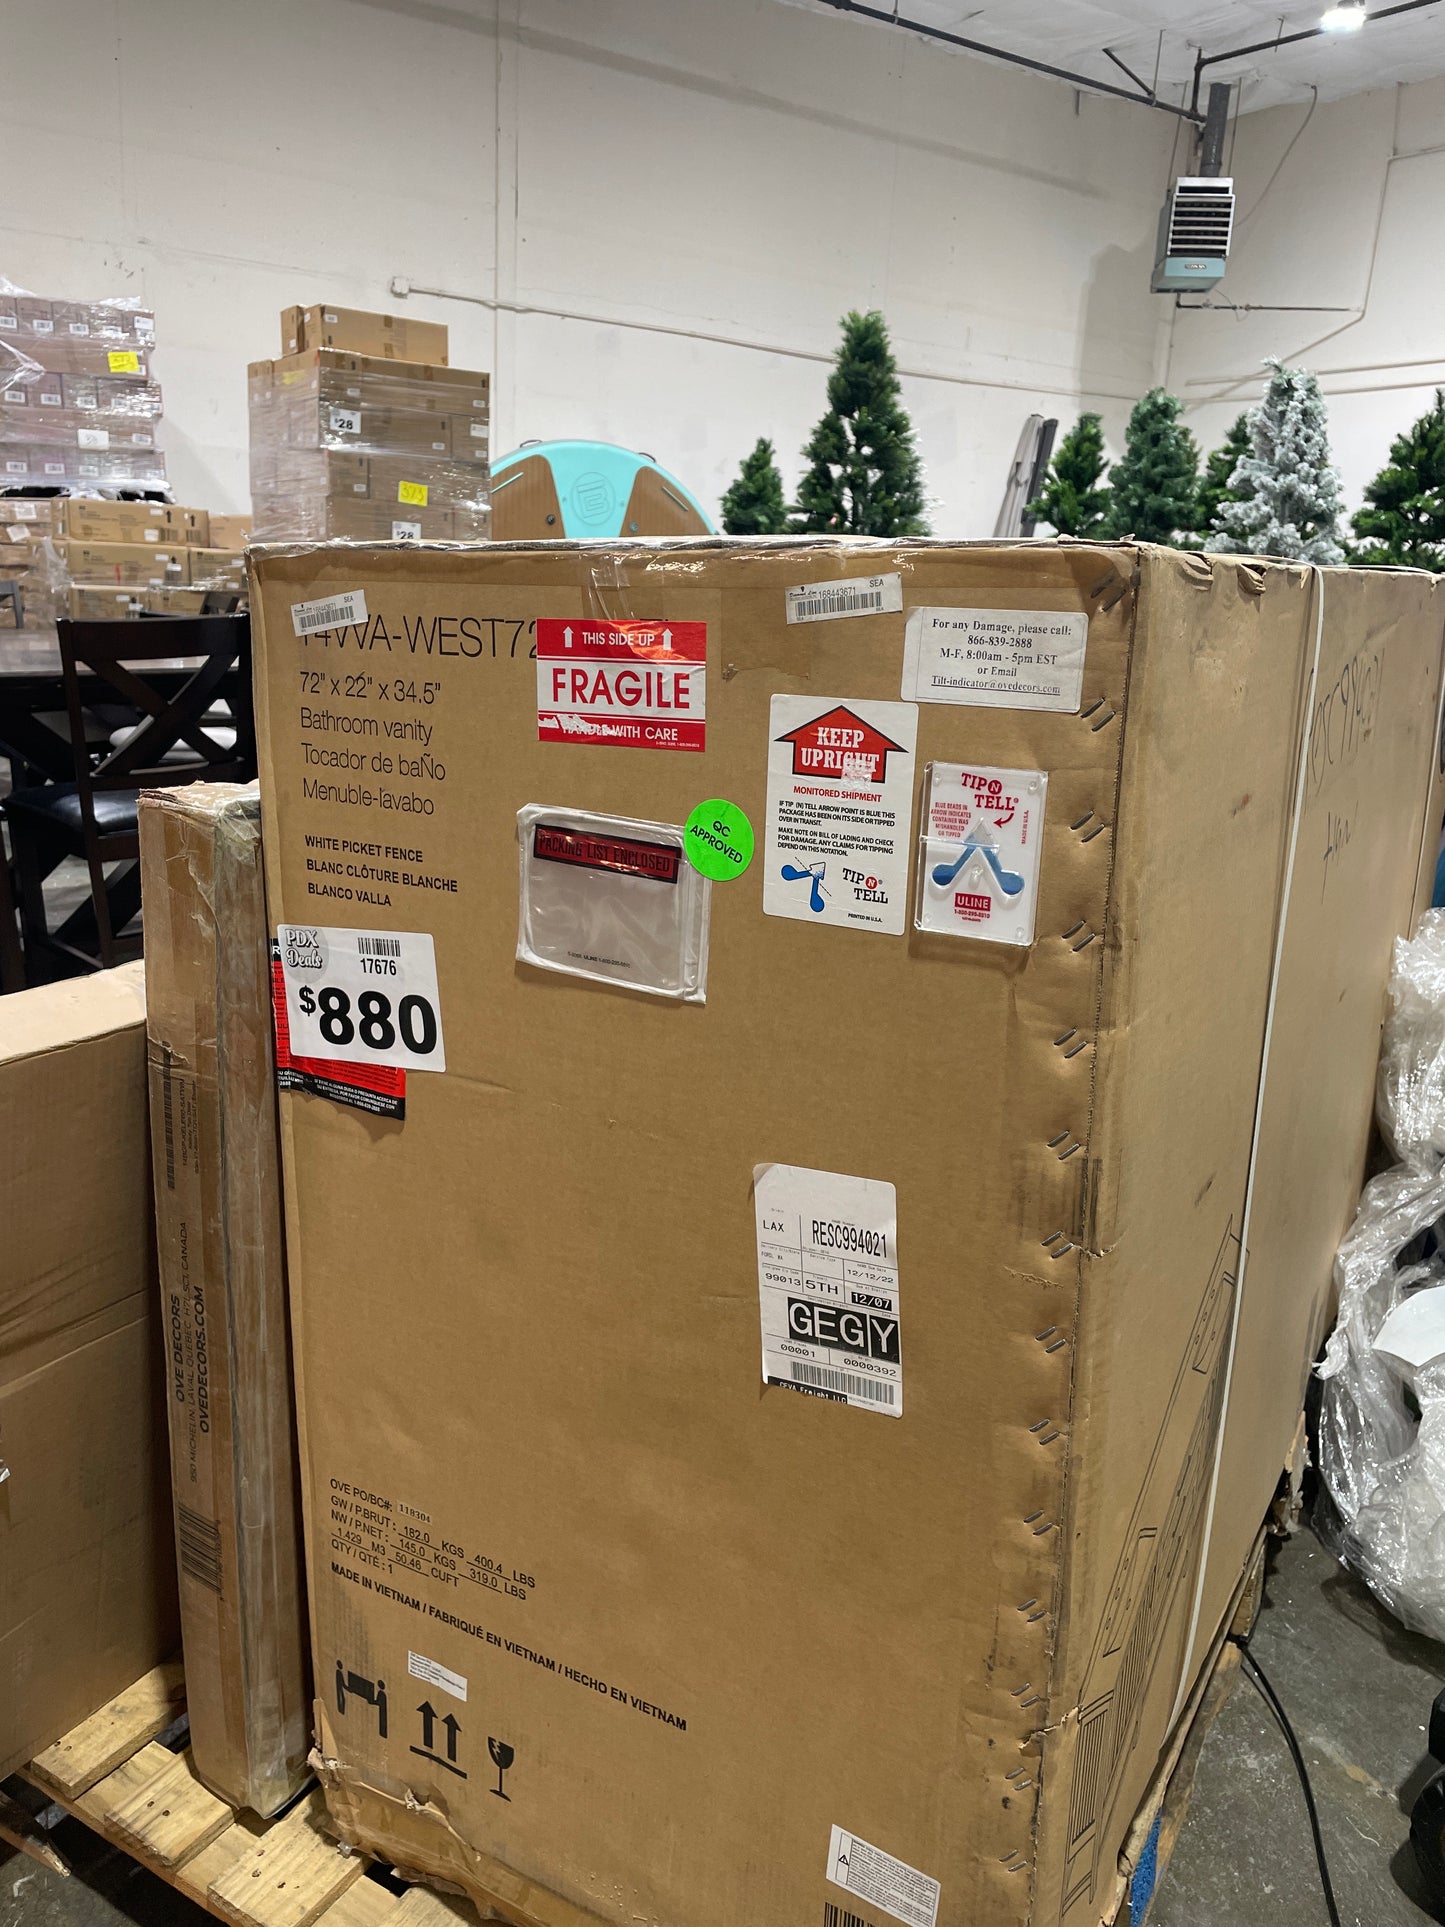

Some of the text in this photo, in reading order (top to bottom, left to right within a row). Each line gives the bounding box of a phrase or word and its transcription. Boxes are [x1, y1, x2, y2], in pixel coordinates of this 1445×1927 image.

[869, 578, 884, 588] SEA
[819, 587, 856, 600] 168443671
[932, 618, 1072, 635] For any Damage, please call:
[582, 632, 655, 646] THIS SIDE UP
[968, 635, 1032, 648] 866-839-2888
[940, 648, 1058, 664] M-F, 8:00am 5pm EST
[991, 666, 1017, 676] Email
[300, 671, 440, 704] 72" x 22" x 34.5"
[552, 668, 690, 708] FRAGILE
[301, 707, 432, 746] Bathroom vanity
[612, 725, 640, 738] WITH
[645, 727, 678, 740] CARE
[817, 727, 864, 748] KEEP
[301, 742, 446, 780] Tocador de baÑo
[801, 748, 880, 772] UPRIGHT
[961, 773, 987, 790] TIP
[303, 778, 434, 815] Menuble-lavabo
[794, 786, 882, 802] MONITORED SHIPMENT
[975, 794, 1016, 811] TELL
[779, 808, 804, 816] PACKAGE
[713, 820, 730, 837] QC
[799, 818, 822, 826] TRANSIT.
[305, 835, 423, 862] WHITE PICKET FENCE
[690, 824, 742, 864] APPROVED
[791, 836, 817, 844] DAMAGE.
[832, 841, 854, 849] CLAIMS
[869, 845, 893, 854] TIPPING
[840, 834, 860, 842] LADING
[875, 838, 894, 846] CHECK
[540, 835, 670, 872] PACKING LIST ENCLOSED
[820, 847, 848, 856] NOTATION.
[307, 859, 458, 892] BLANC CLÔTURE BLANCHE
[842, 868, 864, 884] TIP
[308, 882, 392, 906] BLANCO VALLA
[854, 888, 888, 904] TELL
[957, 896, 988, 908] ULINE
[285, 929, 319, 948] PDX
[286, 948, 322, 968] Deals
[360, 958, 396, 976] 17676
[299, 986, 437, 1054] $880
[763, 1220, 784, 1232] LAX
[180, 1222, 188, 1270] CANADA
[812, 1220, 887, 1258] RESC994021
[765, 1272, 801, 1286] 99013
[848, 1269, 894, 1283] 12/12/22
[805, 1280, 838, 1294] 5TH
[853, 1294, 890, 1309] 12/07
[170, 1294, 186, 1402] OVE DECORS
[780, 1343, 815, 1358] 00001
[194, 1286, 209, 1433] OVEDECORS.COM
[844, 1358, 897, 1377] 0000392
[186, 1370, 196, 1405] LAVAL
[780, 1382, 796, 1392] CEVA
[800, 1386, 829, 1399] Freight
[330, 1478, 351, 1494] OVE
[400, 1504, 430, 1523] 118304
[331, 1496, 348, 1510] GW
[404, 1526, 430, 1543] 182.0
[442, 1540, 464, 1558] KGS
[474, 1555, 502, 1574] 400.4
[513, 1570, 535, 1588] LBS
[332, 1509, 347, 1524] NW
[400, 1539, 425, 1556] 145.0
[434, 1552, 456, 1570] KGS
[470, 1568, 498, 1588] 319.0
[504, 1582, 526, 1600] LBS
[332, 1539, 392, 1574] QTY QTÉ 1
[338, 1528, 459, 1587] 1.429 M3 50.46 CUFT
[331, 1562, 686, 1730] MADE IN VIETNAM FABRIQUÉ EN VIETNAM HECHO EN VIETNAM
